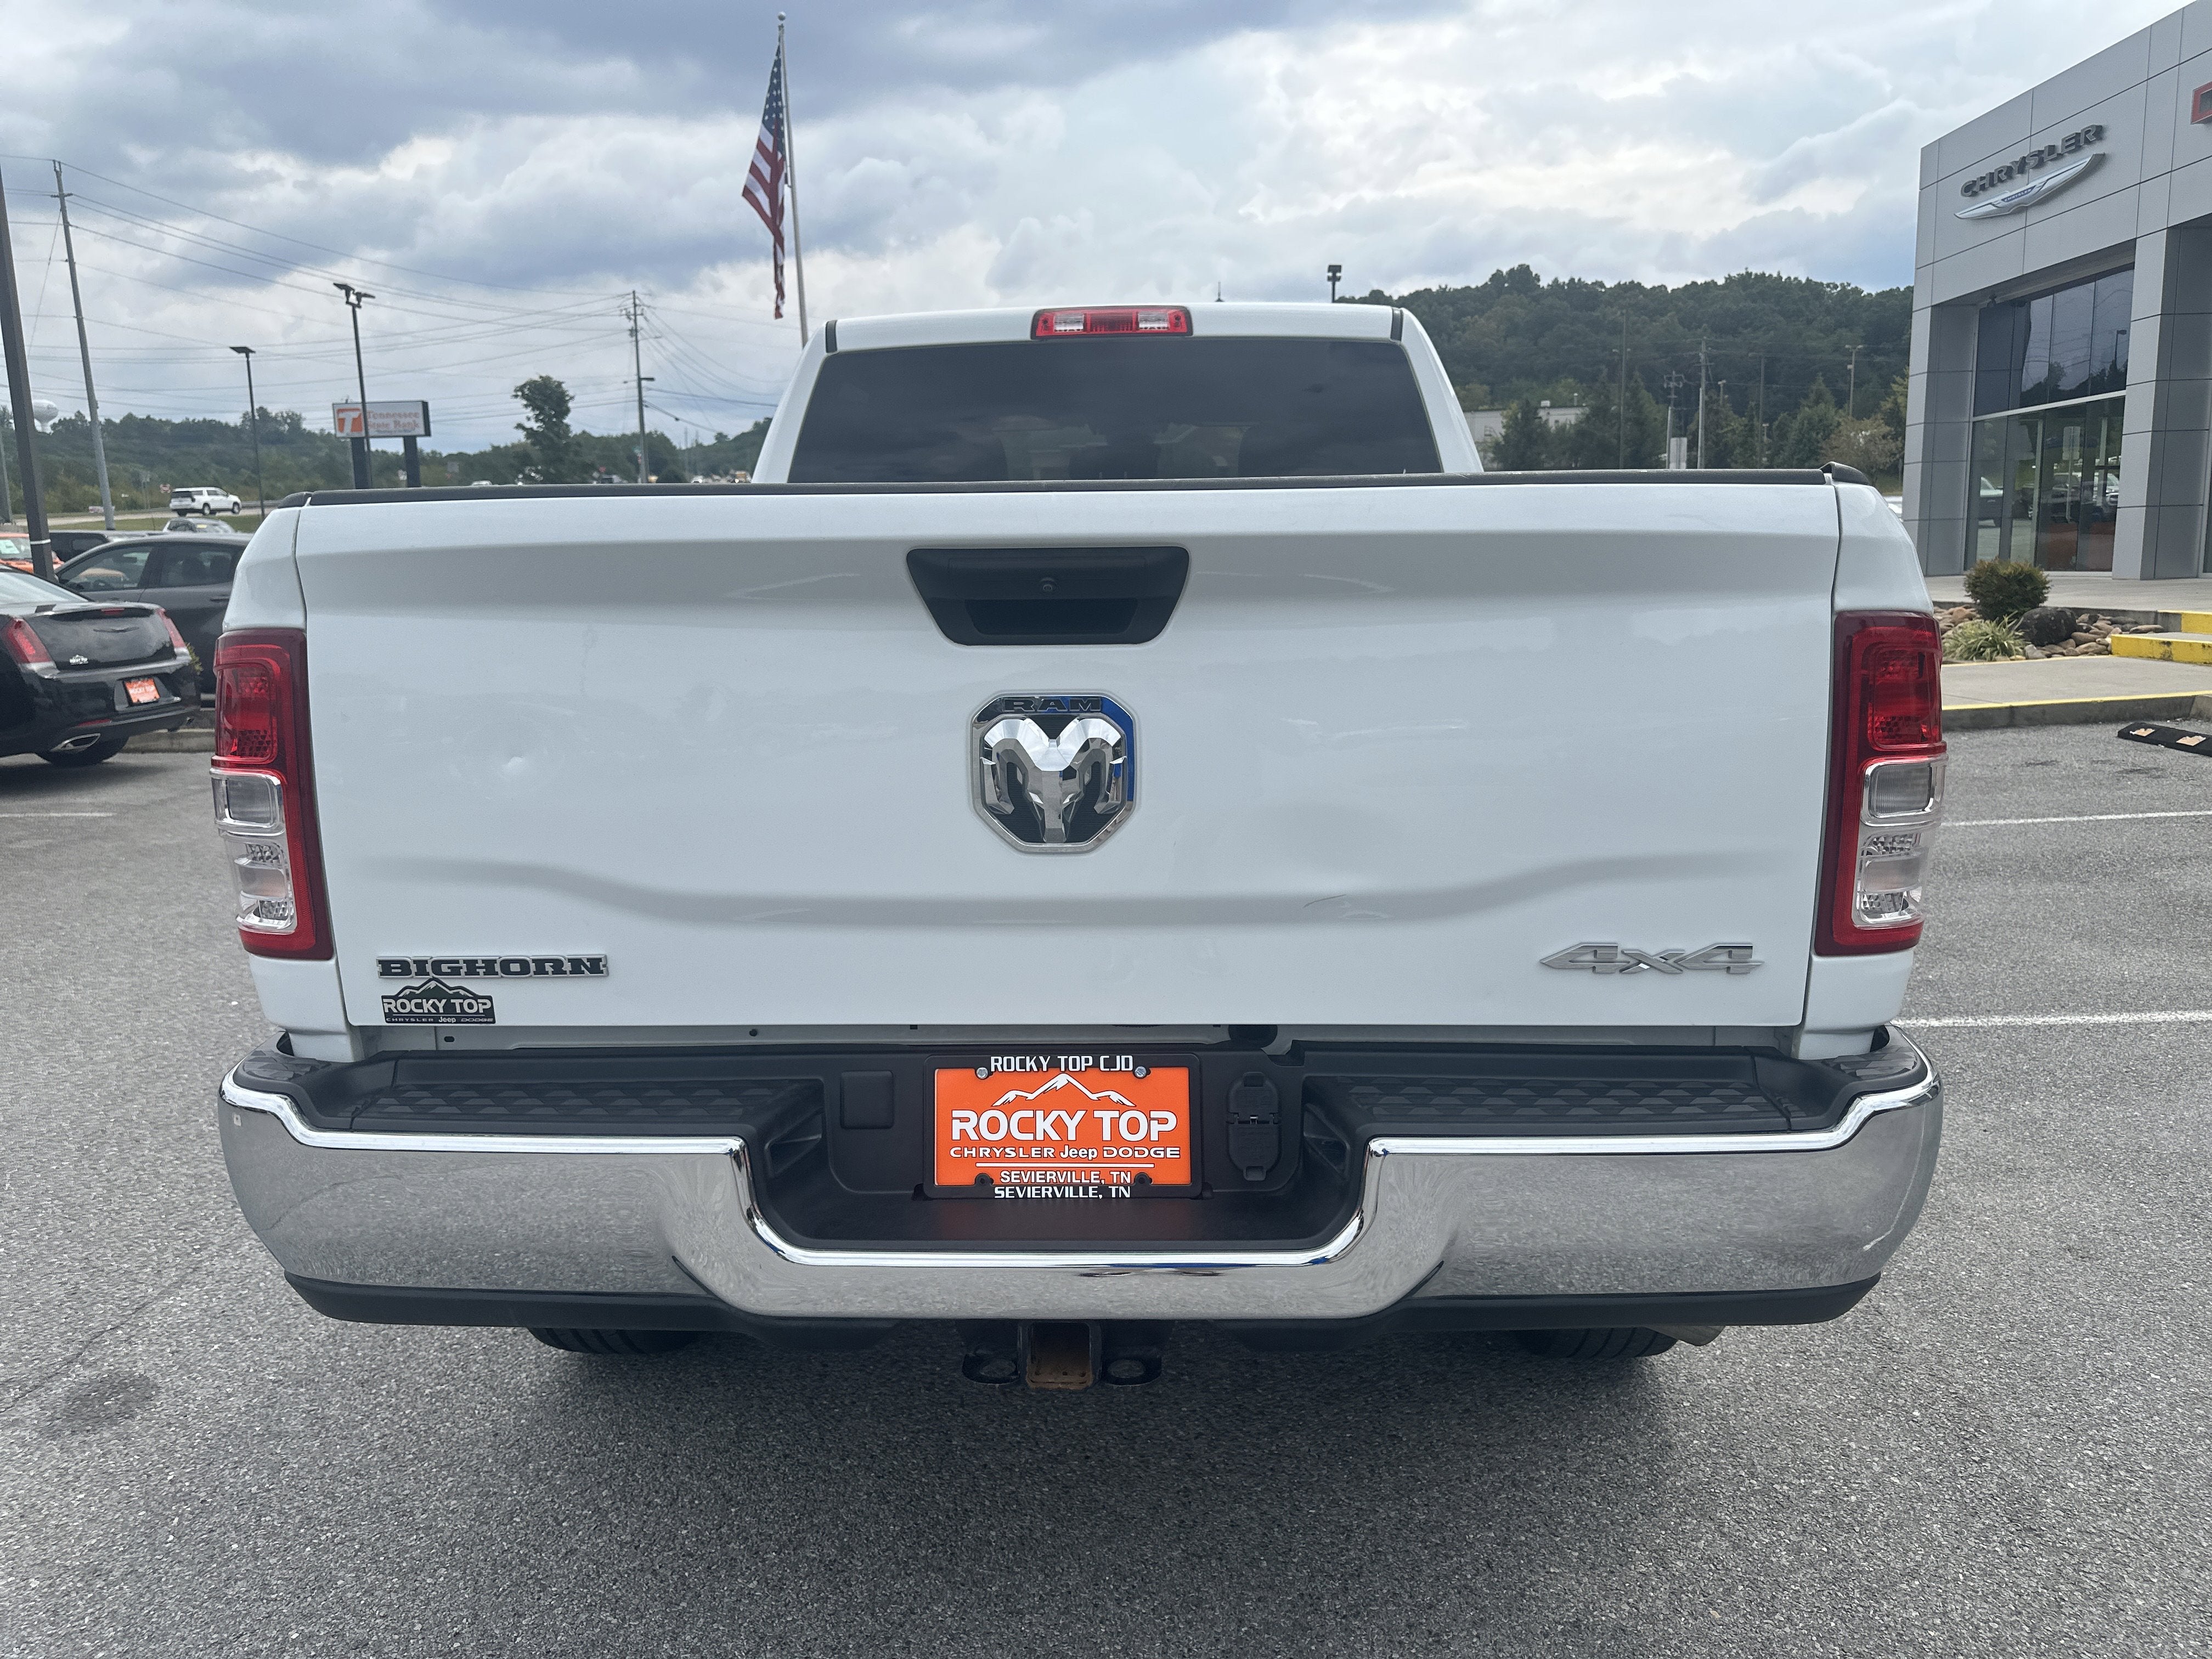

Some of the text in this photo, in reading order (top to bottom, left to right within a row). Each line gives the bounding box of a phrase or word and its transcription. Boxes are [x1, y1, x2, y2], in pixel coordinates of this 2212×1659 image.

[1961, 125, 2102, 196] CHRYSLER
[367, 410, 420, 419] Tennessee
[1003, 698, 1101, 712] RAM
[376, 955, 609, 979] BIGHORN
[383, 998, 492, 1013] ROCKY TOP
[991, 1055, 1133, 1071] ROCKY TOP CJD
[951, 1110, 1177, 1141] ROCKY TOP
[950, 1145, 1180, 1160] CHRYSLER Jeep DODGE
[1000, 1170, 1131, 1184] SEVIERVILLE, TN
[995, 1186, 1130, 1199] SEVIERVILLE, TN
